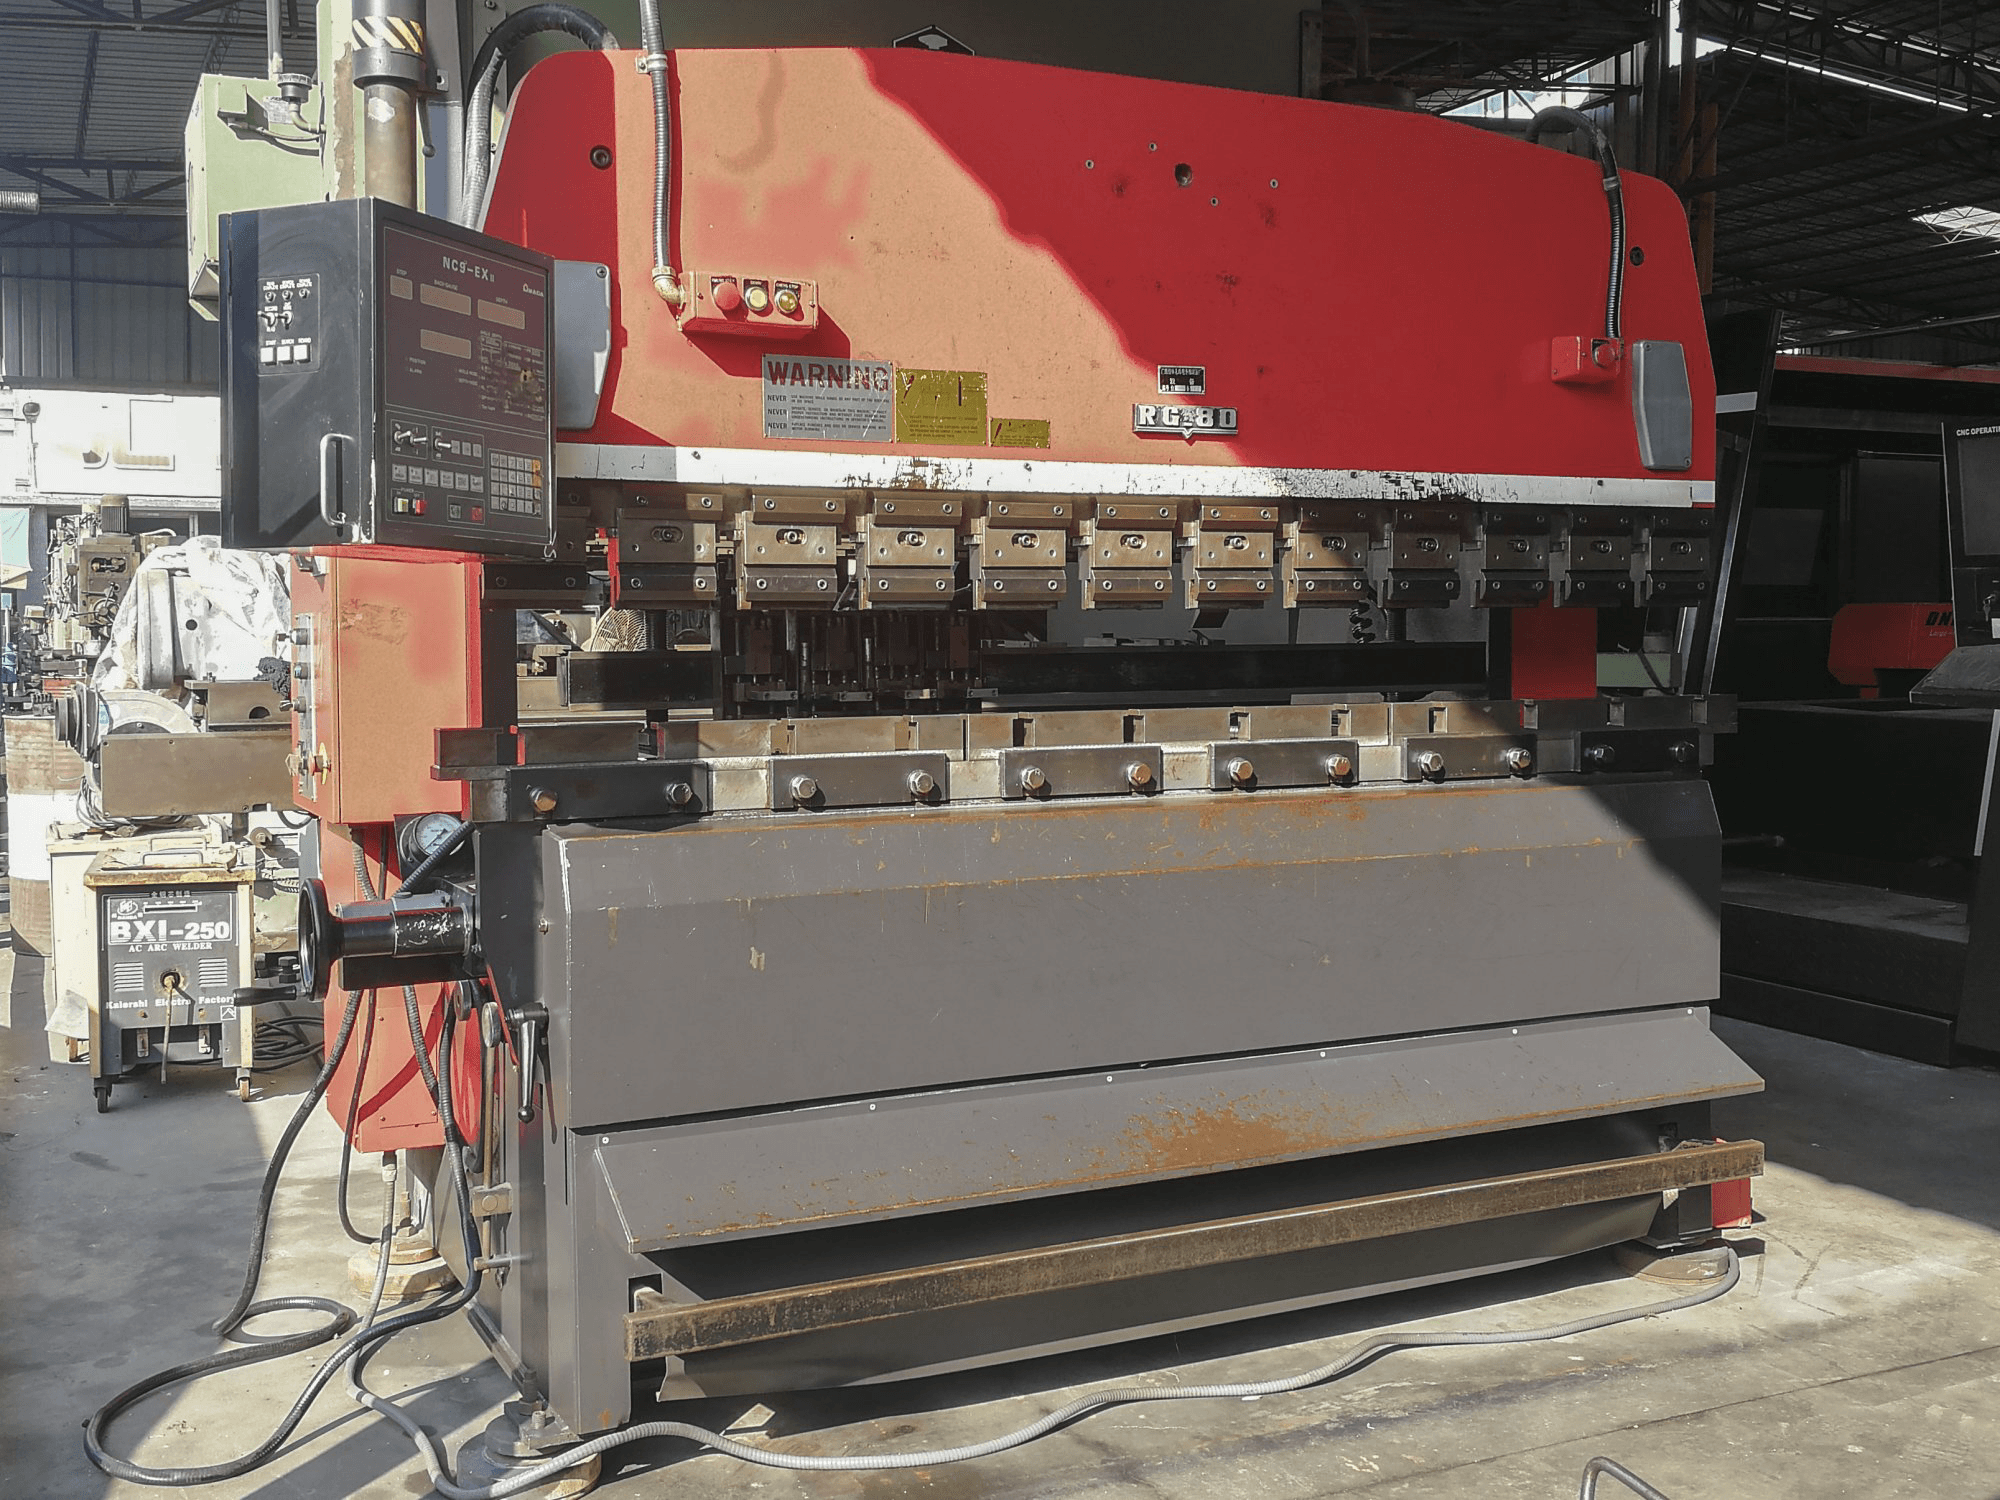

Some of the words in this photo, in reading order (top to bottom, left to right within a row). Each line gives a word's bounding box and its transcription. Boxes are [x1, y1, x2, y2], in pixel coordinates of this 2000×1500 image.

[767, 360, 889, 392] WARNING
[767, 394, 787, 402] NEVER
[767, 408, 787, 416] NEVER
[768, 421, 788, 430] NEVER
[1956, 428, 1970, 437] CNC
[128, 944, 143, 953] AC
[147, 943, 168, 952] ARC
[173, 942, 213, 951] WELDER
[199, 995, 236, 1005] Factory
